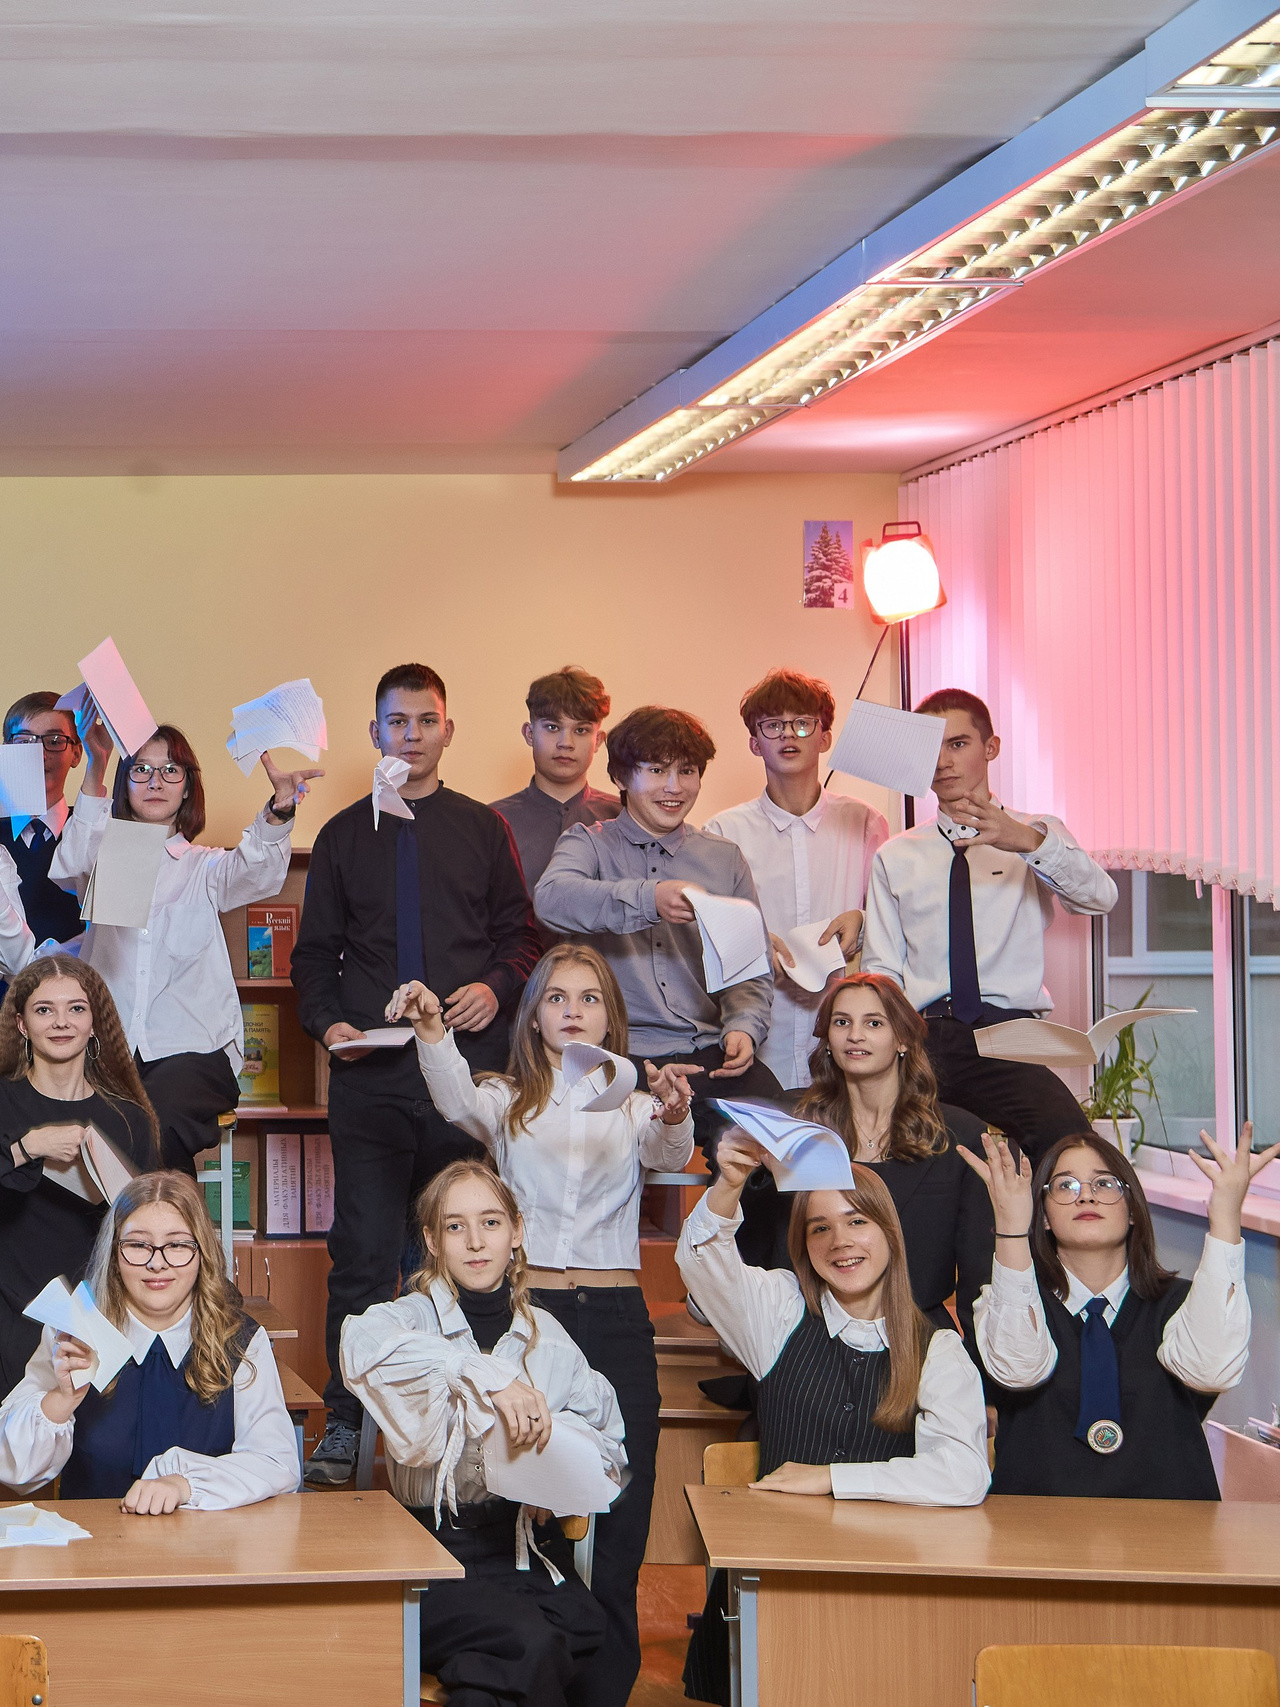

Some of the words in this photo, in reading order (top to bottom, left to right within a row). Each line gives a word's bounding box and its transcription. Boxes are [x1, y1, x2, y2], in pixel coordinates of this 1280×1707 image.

[837, 588, 848, 603] 4
[265, 912, 291, 926] Русский
[281, 1137, 289, 1210] ФАКУЛЬТАТИВНЫХ
[289, 1165, 297, 1200] ЗАНЯТИЙ
[282, 1212, 290, 1229] ДЛЯ
